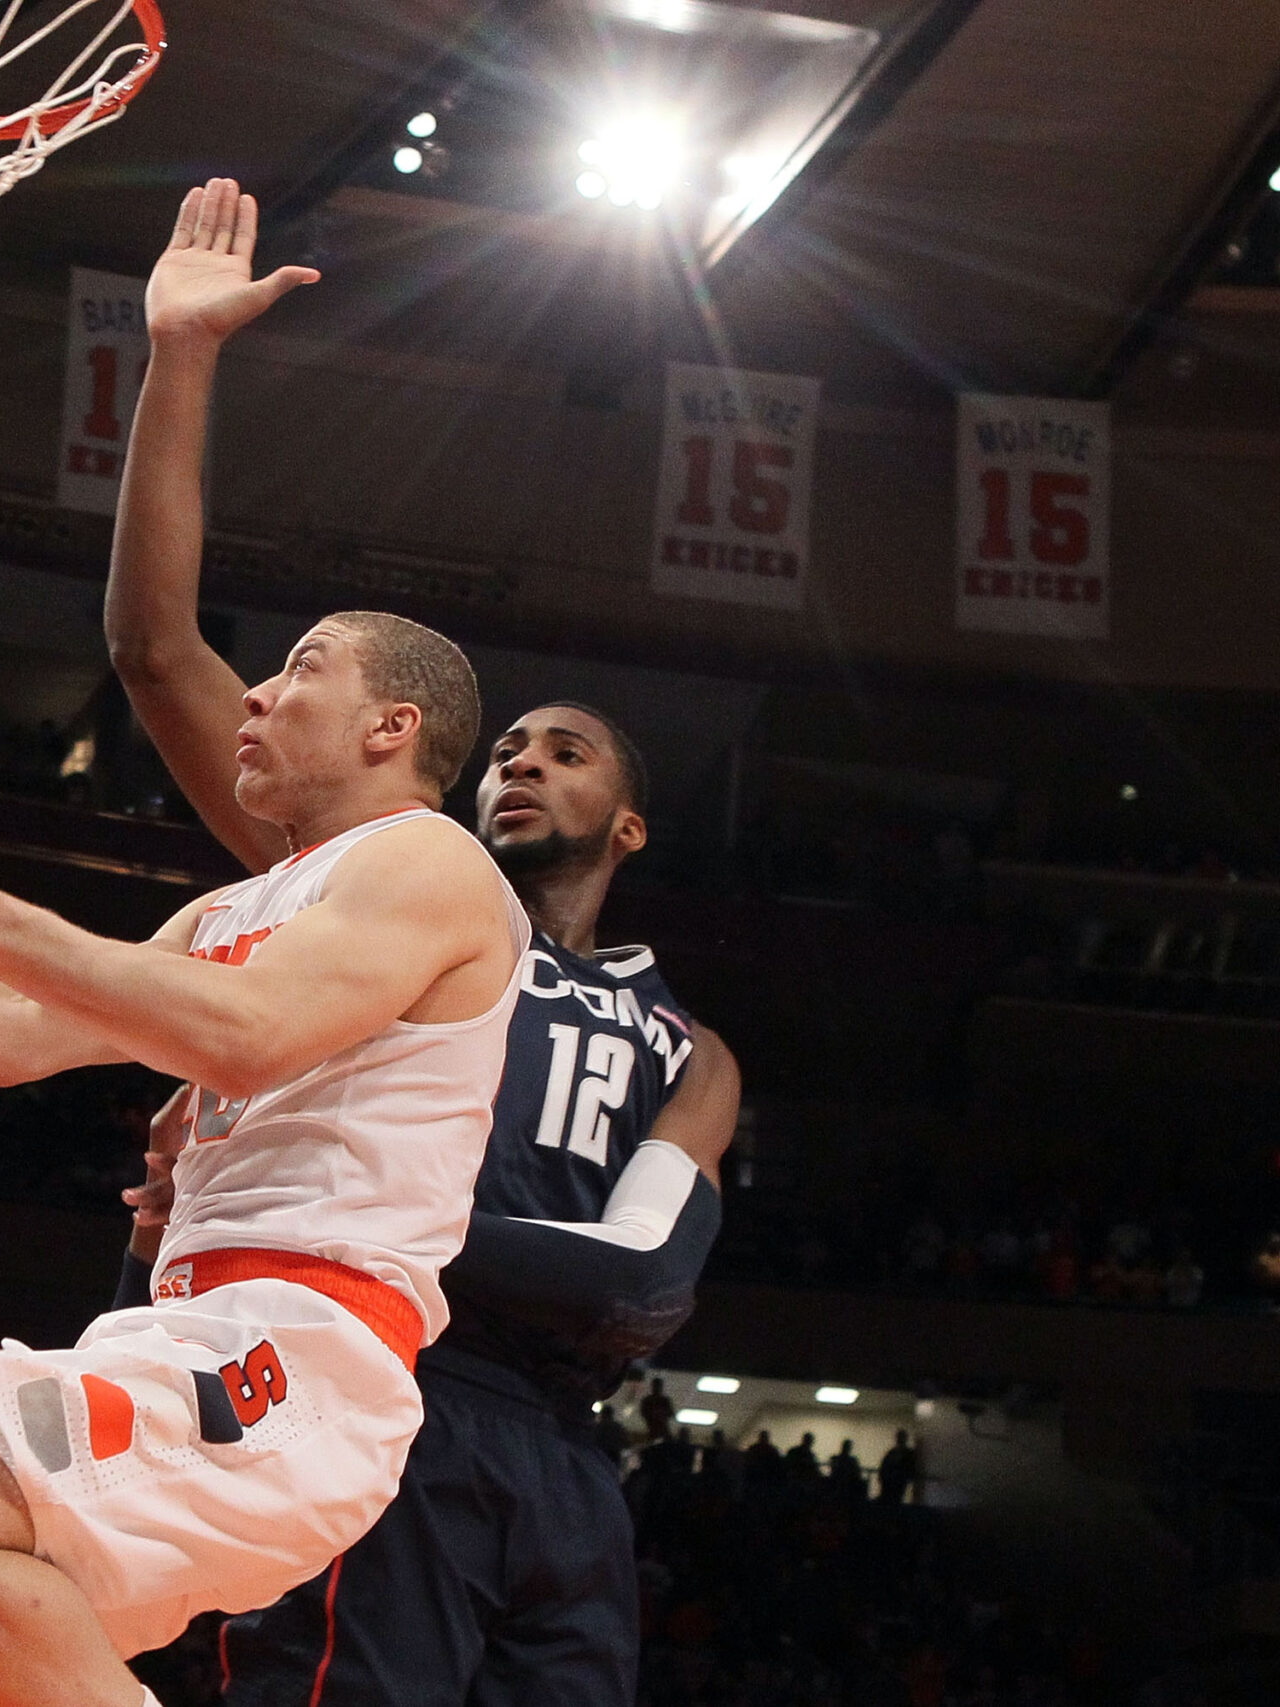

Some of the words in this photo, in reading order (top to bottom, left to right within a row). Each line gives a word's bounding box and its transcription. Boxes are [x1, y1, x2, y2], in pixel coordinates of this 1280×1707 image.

[678, 434, 794, 535] 15
[978, 470, 1092, 566] 15
[964, 566, 1103, 605] KNICKS
[534, 1022, 635, 1168] 12
